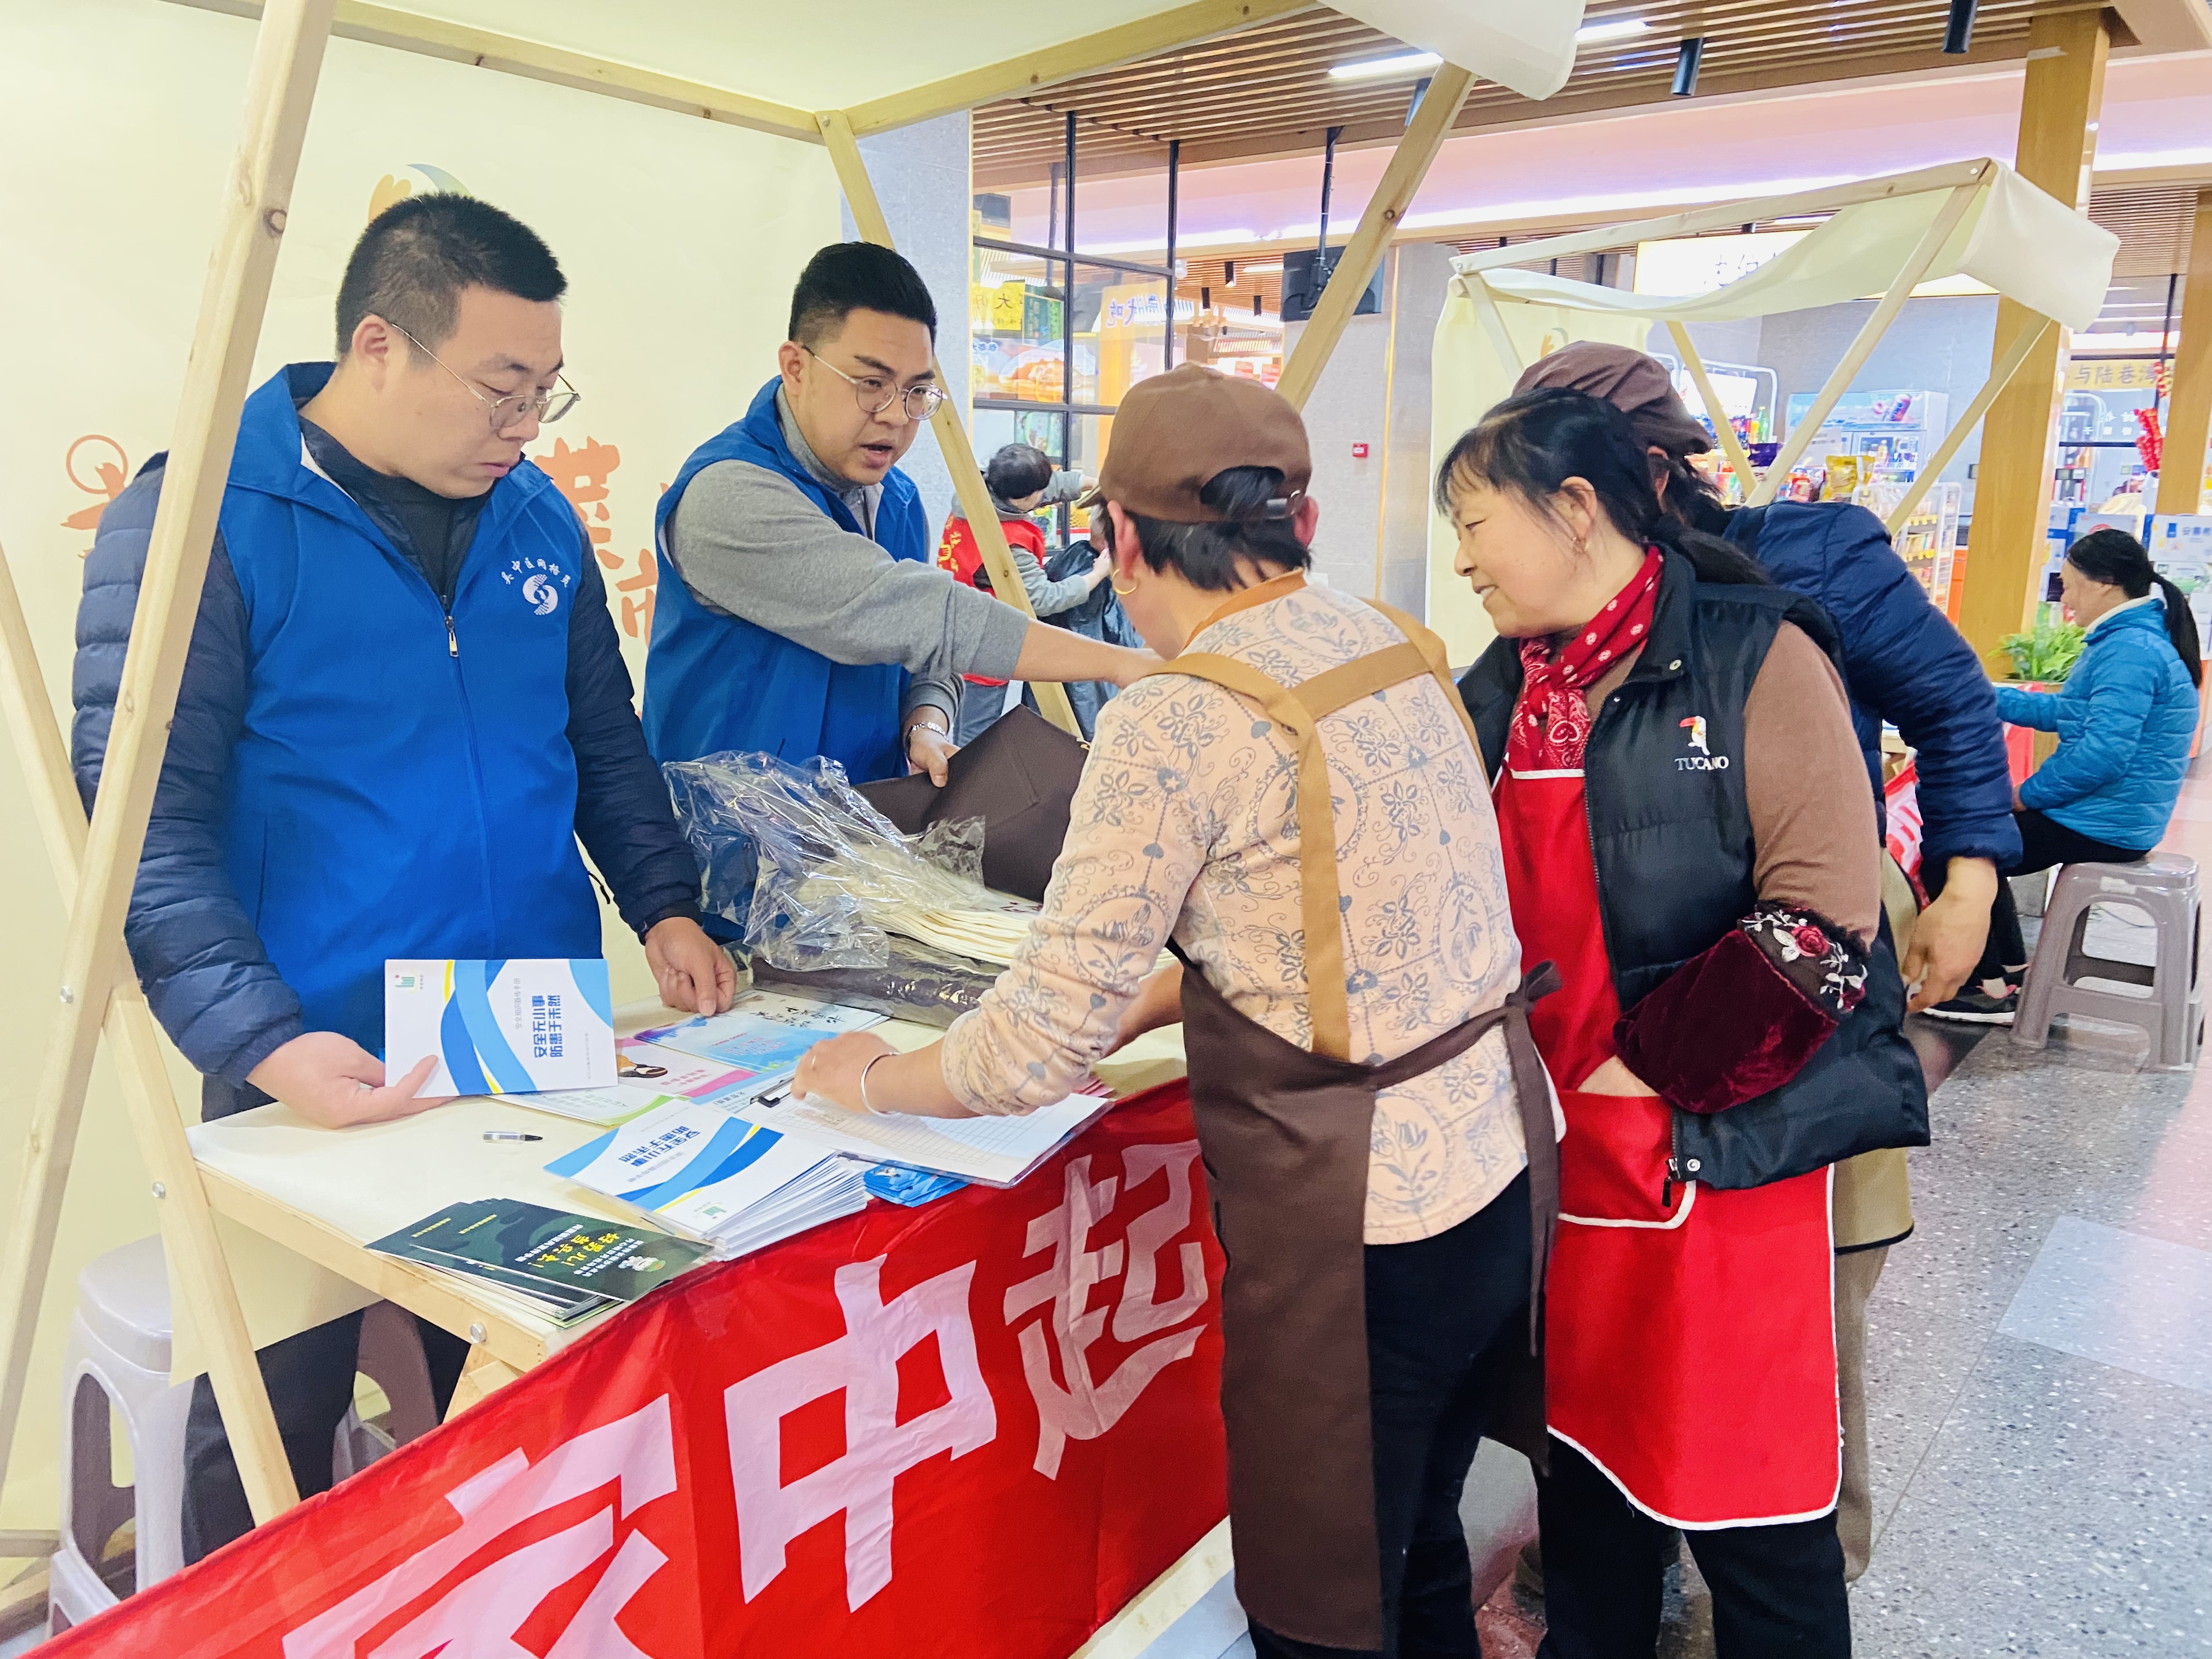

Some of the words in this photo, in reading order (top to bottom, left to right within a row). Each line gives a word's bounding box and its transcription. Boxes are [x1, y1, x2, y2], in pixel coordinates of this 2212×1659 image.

[501, 557, 571, 588] 吴中区网格员
[532, 995, 548, 1058] 安全无小事
[547, 995, 563, 1057] 防患于未然
[618, 1126, 690, 1163] 防患于未然
[630, 1131, 701, 1167] 安全无小事
